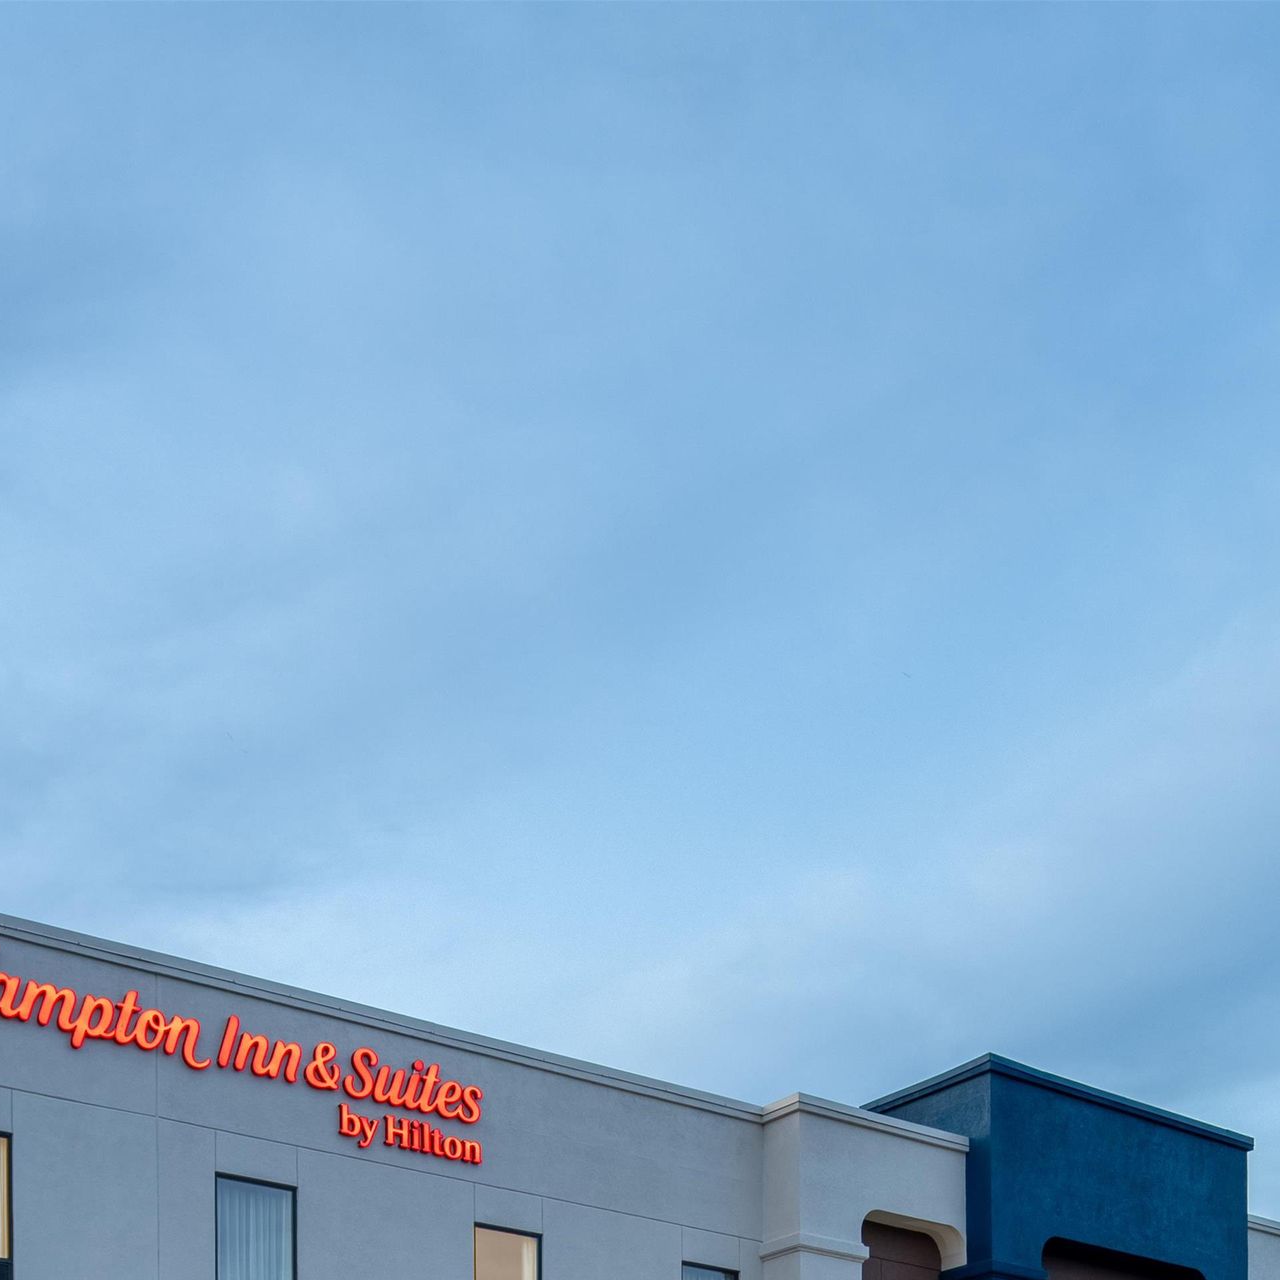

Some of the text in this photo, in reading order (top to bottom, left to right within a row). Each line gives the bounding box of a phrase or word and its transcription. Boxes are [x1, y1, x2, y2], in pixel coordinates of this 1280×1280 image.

[217, 1014, 303, 1084] Inn
[343, 1046, 484, 1125] Suites
[338, 1103, 484, 1165] by Hilton
